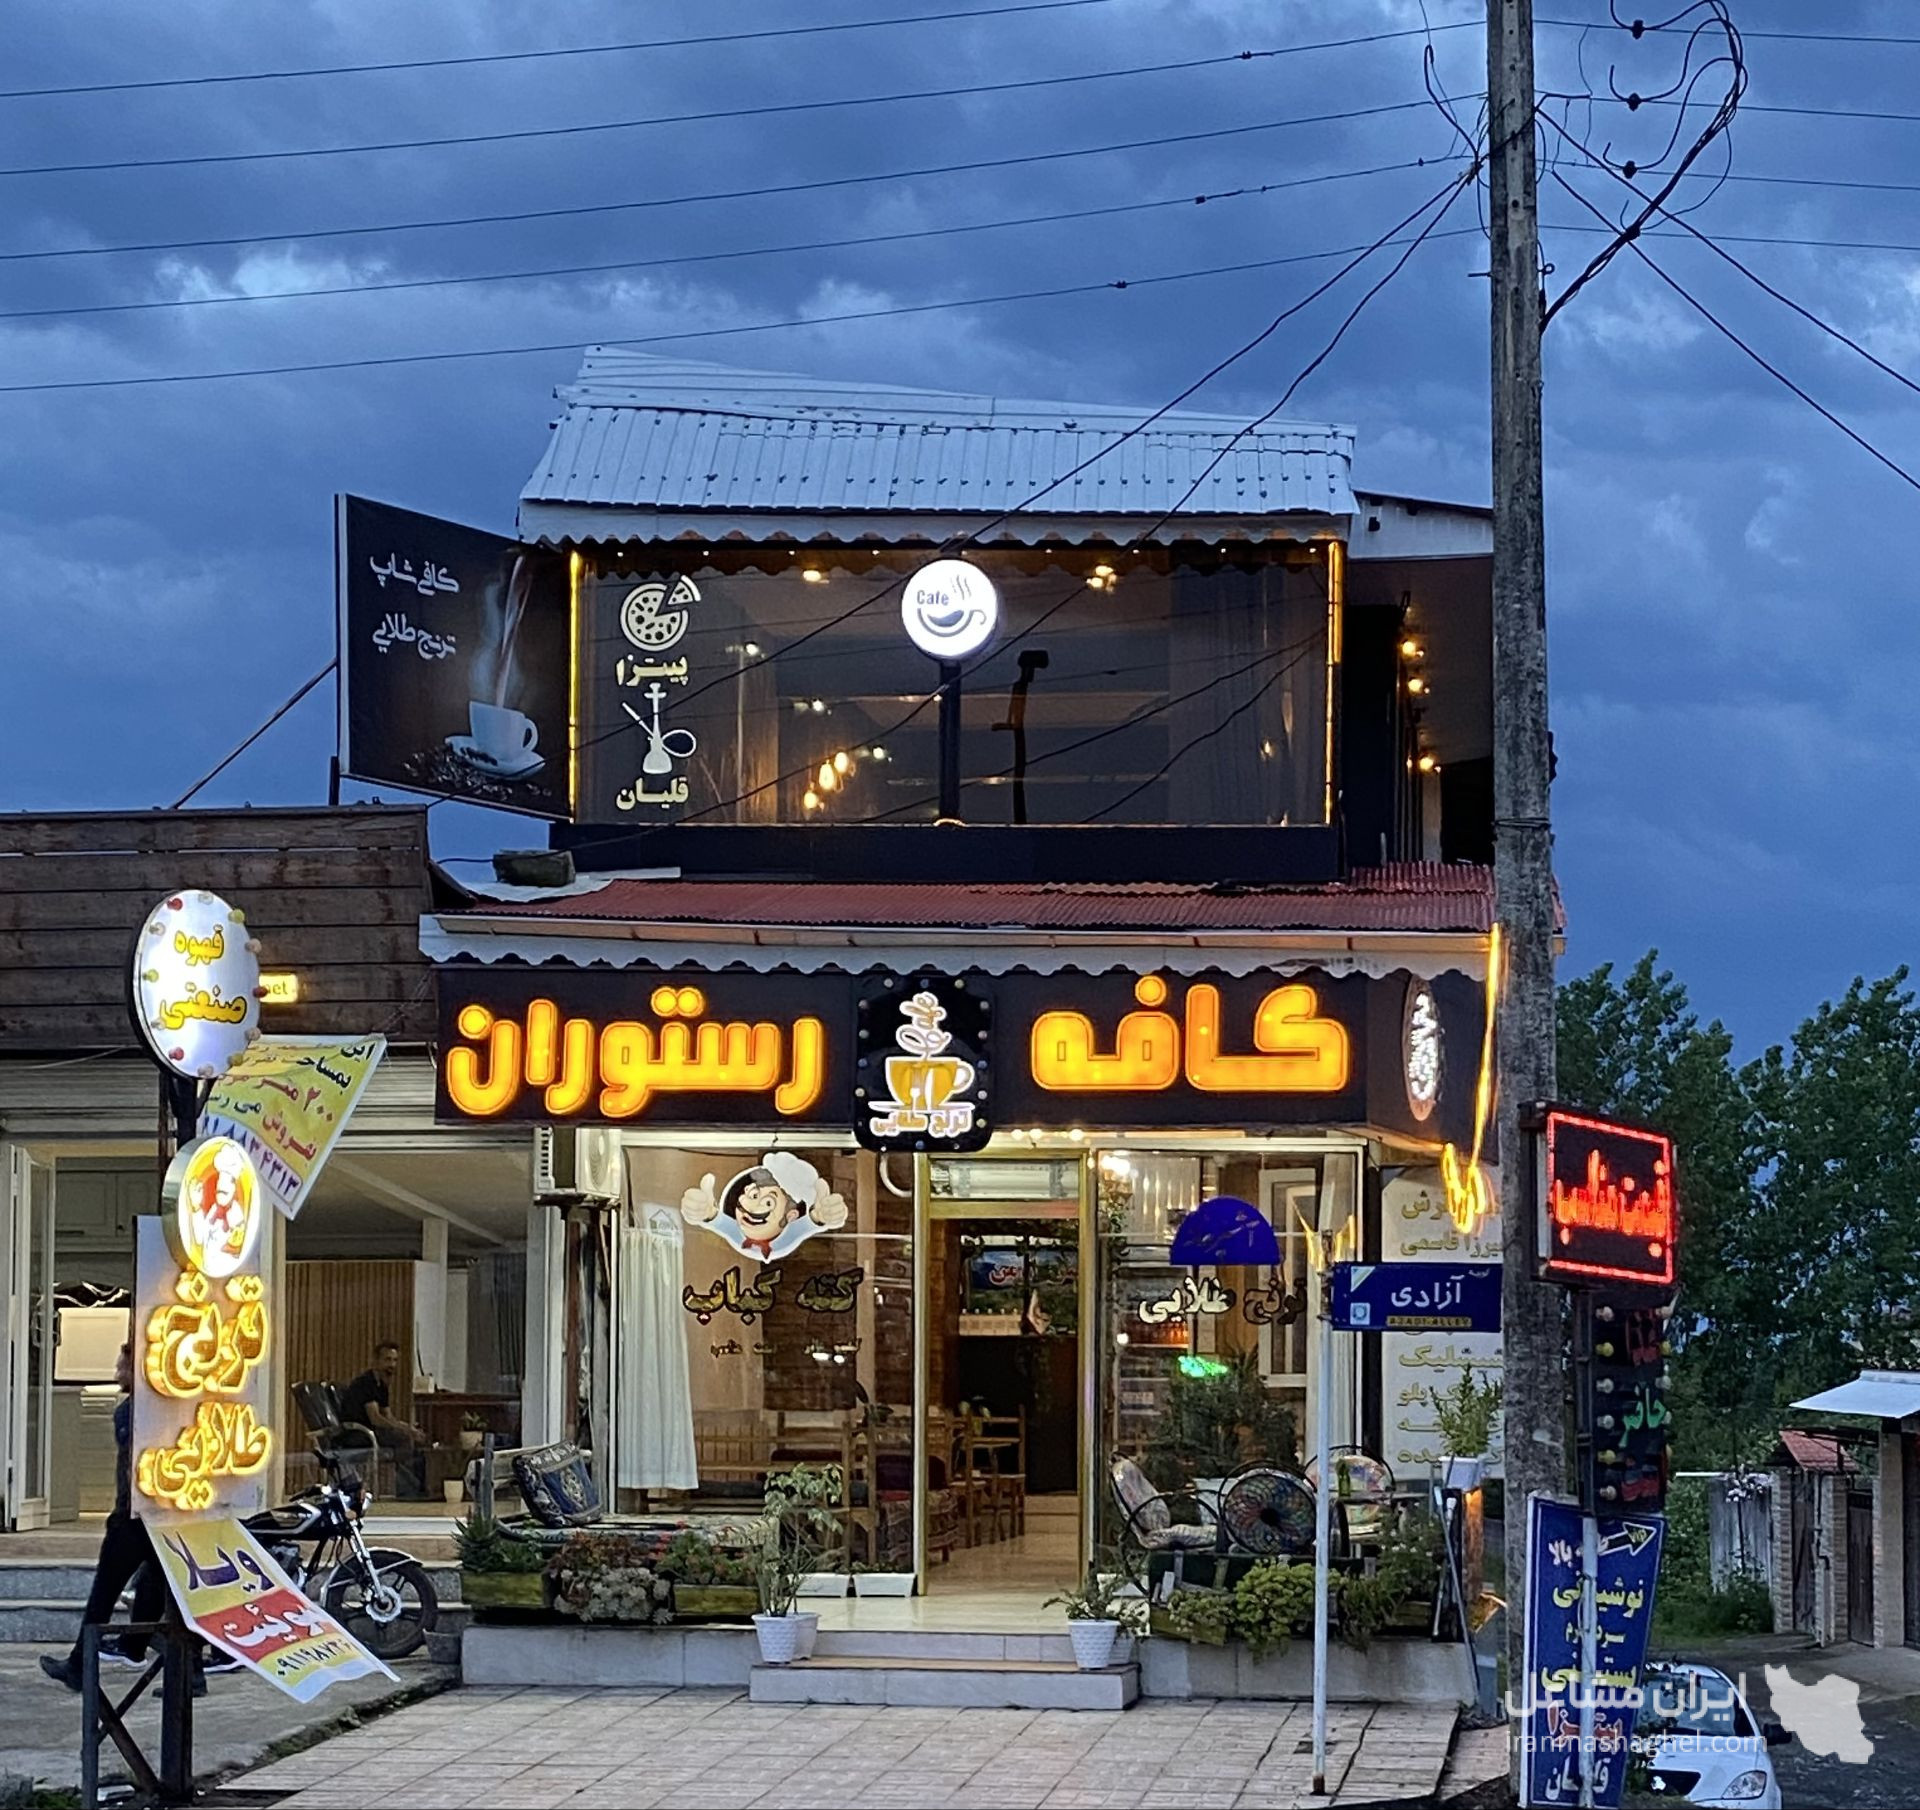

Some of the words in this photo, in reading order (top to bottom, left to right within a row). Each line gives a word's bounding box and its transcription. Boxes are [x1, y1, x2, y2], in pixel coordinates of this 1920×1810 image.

[368, 552, 418, 588] شاپ
[416, 562, 460, 597] کافی
[917, 589, 949, 606] Cafe
[416, 630, 456, 660] ترنج
[616, 654, 689, 687] پیتزا
[616, 778, 689, 810] قلیان
[174, 924, 225, 967] قهوه
[159, 982, 248, 1031] صنعتی
[446, 985, 823, 1119] رستوران
[1031, 974, 1349, 1092] کافه
[682, 1266, 783, 1326] کباب
[1391, 1275, 1465, 1310] آزادی
[144, 1270, 269, 1398] ترنج
[137, 1400, 271, 1510] طلایی
[161, 1530, 275, 1592] ویلا
